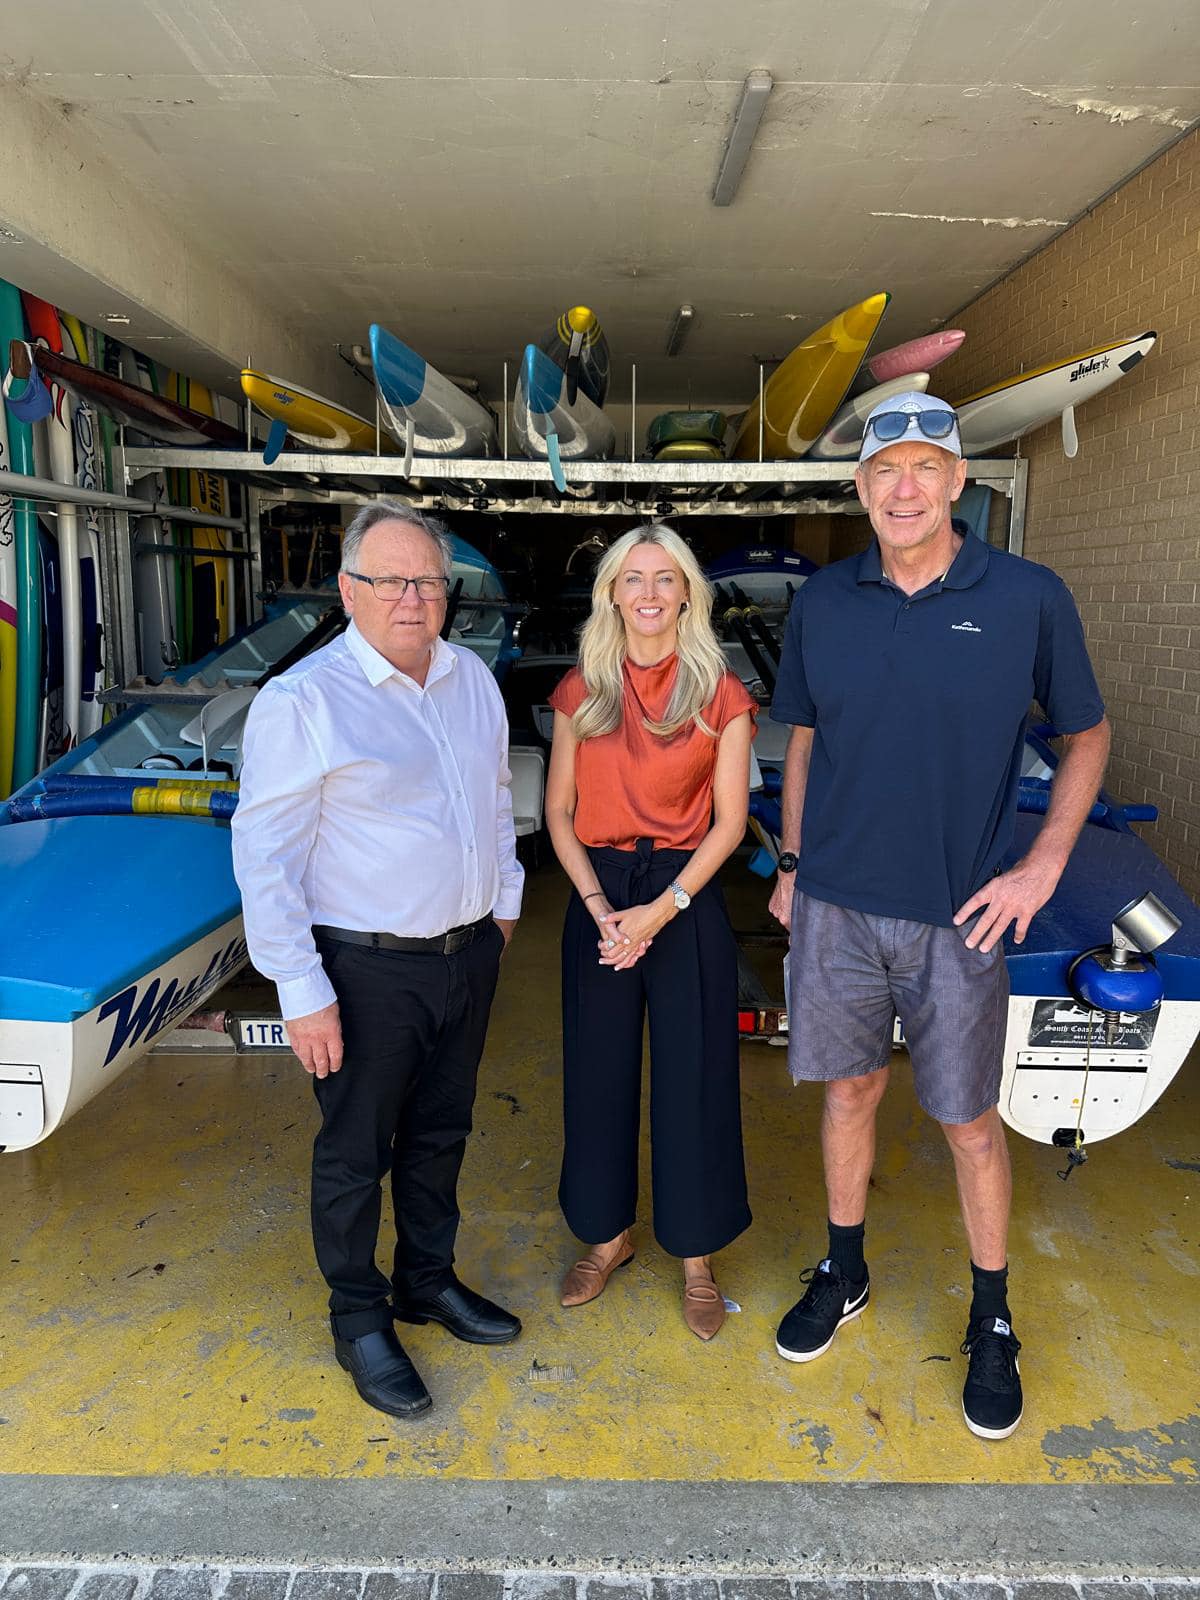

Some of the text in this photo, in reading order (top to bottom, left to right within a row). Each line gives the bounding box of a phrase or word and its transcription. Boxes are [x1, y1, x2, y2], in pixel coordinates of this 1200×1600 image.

[1070, 359, 1102, 382] glide
[246, 1024, 284, 1044] 1TR
[1044, 1025, 1069, 1033] South
[1071, 1025, 1093, 1034] Coast
